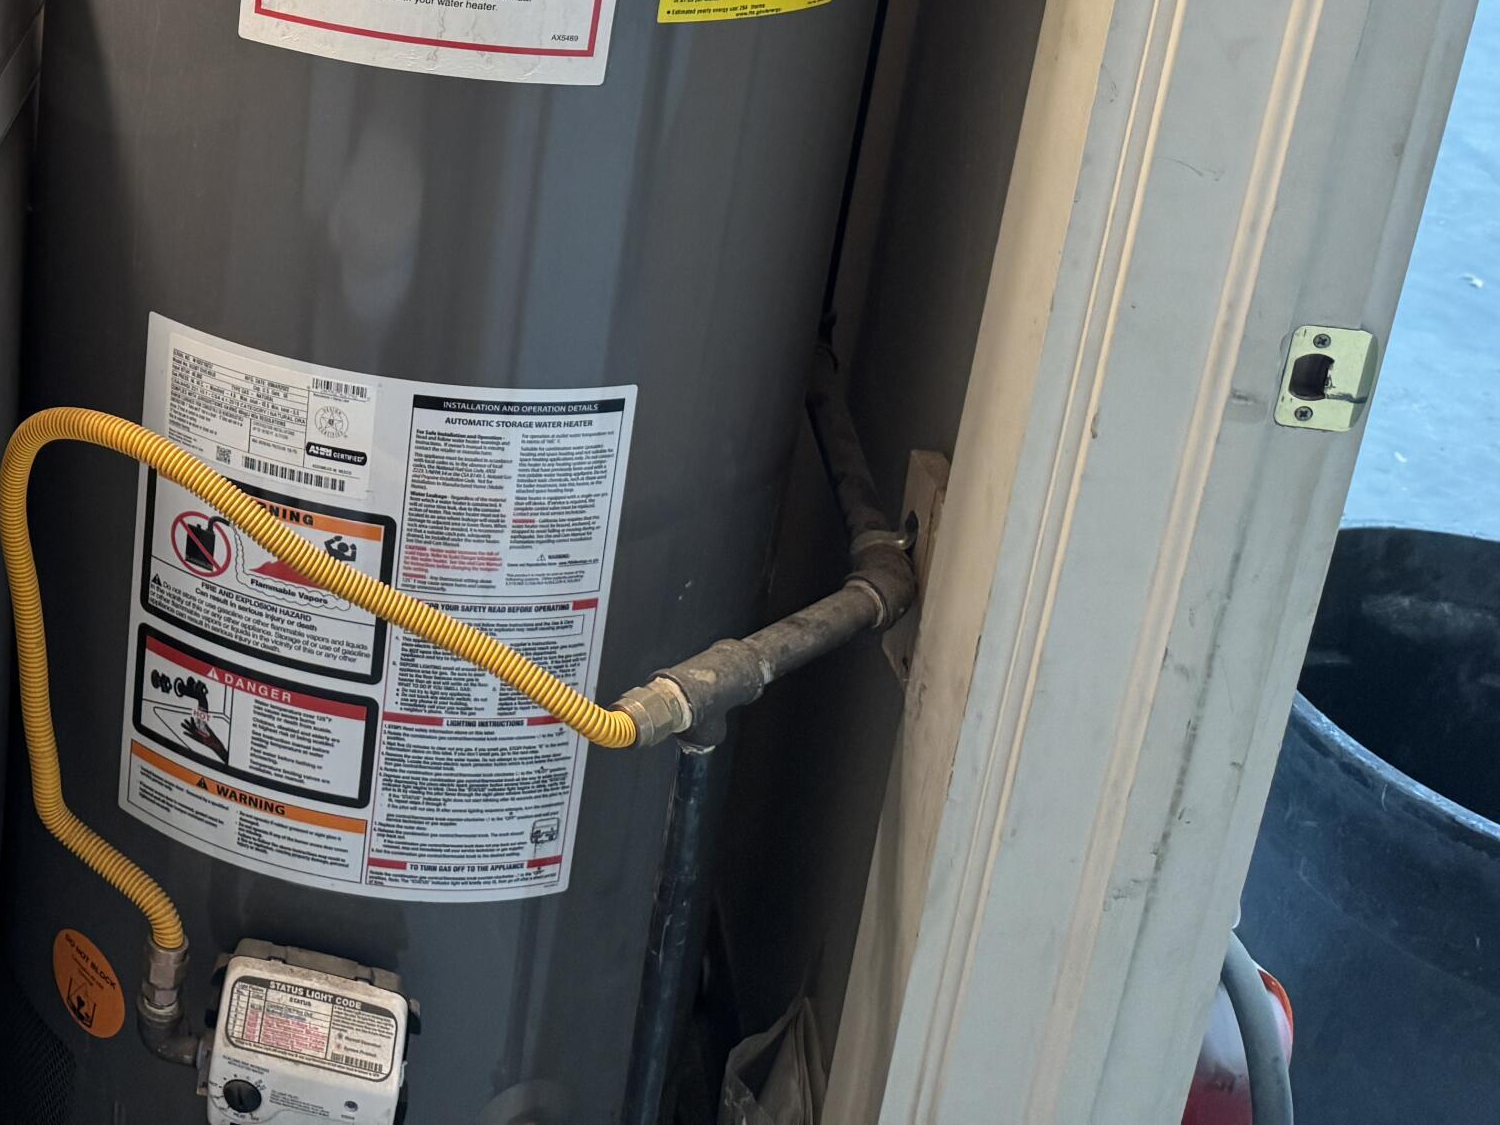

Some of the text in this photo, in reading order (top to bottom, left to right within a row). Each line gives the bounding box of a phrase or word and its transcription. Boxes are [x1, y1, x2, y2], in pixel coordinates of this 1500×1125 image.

[437, 0, 463, 7] water
[465, 0, 496, 10] heater.
[443, 401, 500, 411] INSTALLATION
[567, 403, 598, 411] DETAILS
[445, 417, 494, 427] AUTOMATIC
[495, 420, 533, 428] STORAGE
[563, 419, 592, 427] HEATER
[257, 501, 314, 526] NING
[250, 578, 328, 605] Flammable Vapors
[194, 587, 208, 597] Can
[209, 594, 228, 605] result
[229, 600, 236, 608] in
[238, 602, 263, 617] serious
[264, 612, 285, 624] injury
[296, 621, 317, 631] death
[201, 581, 311, 621] FIRE AND EXPLOSION HAZARD
[440, 603, 459, 611] YOUR
[534, 603, 569, 612] OPERATING
[224, 674, 292, 703] DANGER
[193, 709, 211, 721] HOT
[446, 719, 524, 727] LIGHTING INSTRUCTIONS
[217, 784, 285, 815] WARNING
[438, 864, 451, 872] GAS
[490, 862, 524, 871] APPLIANCE
[269, 981, 362, 1009] STATUS LIGHT CODE
